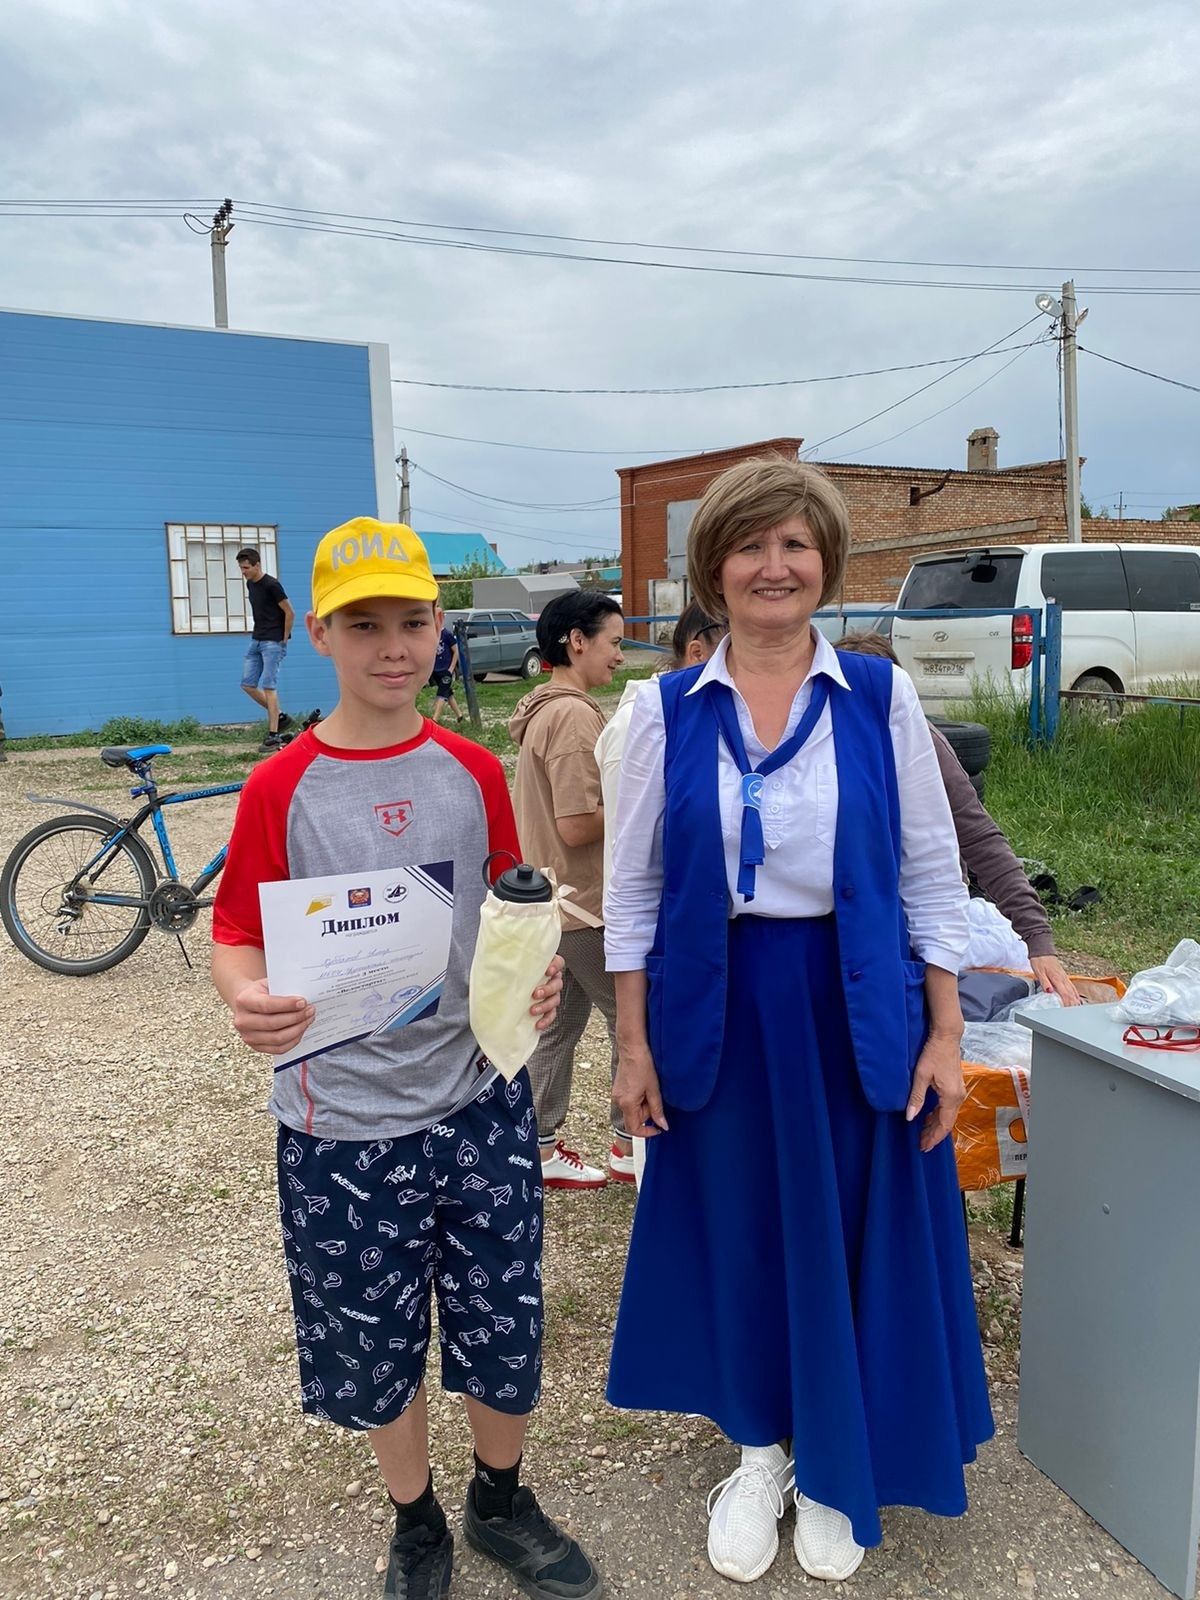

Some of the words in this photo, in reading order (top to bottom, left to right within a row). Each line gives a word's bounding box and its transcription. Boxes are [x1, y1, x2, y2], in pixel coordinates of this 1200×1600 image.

[332, 531, 410, 571] ЮИД
[321, 912, 400, 937] Диплом
[445, 1231, 473, 1257] COOL
[448, 1340, 473, 1368] COOL
